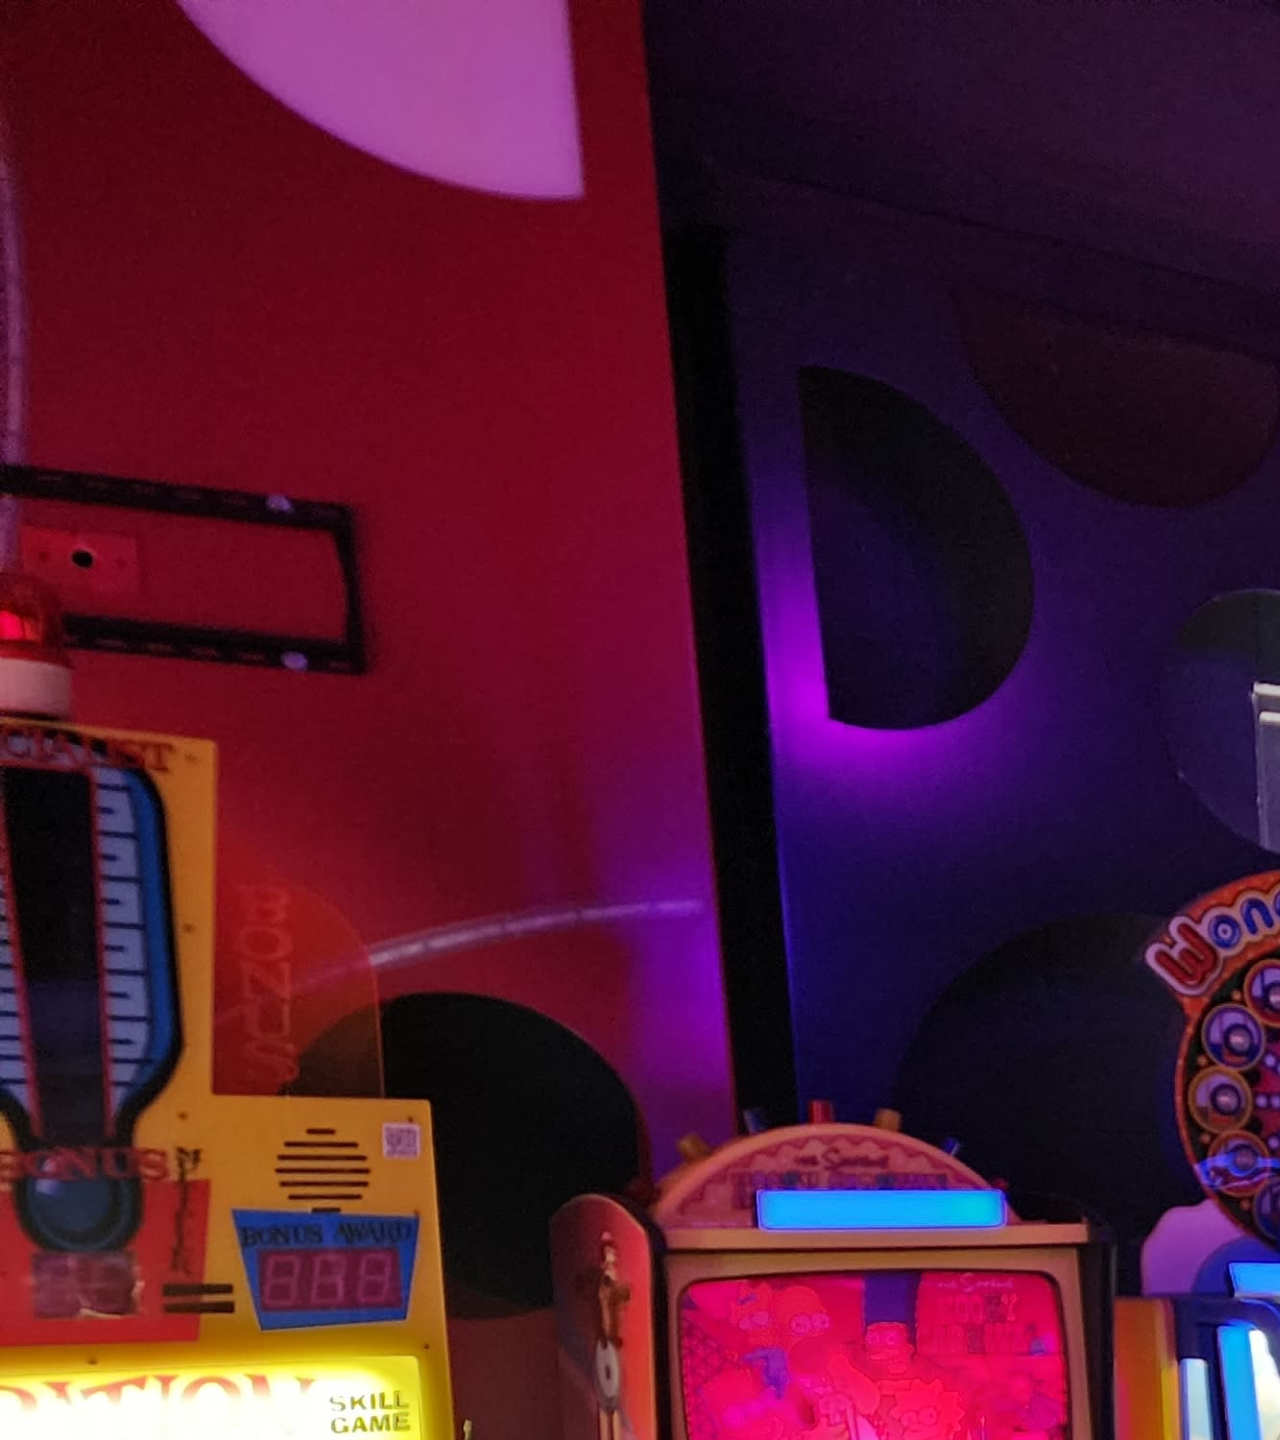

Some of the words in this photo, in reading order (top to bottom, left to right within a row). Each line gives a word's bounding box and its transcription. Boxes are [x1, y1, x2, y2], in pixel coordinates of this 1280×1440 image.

[243, 1224, 323, 1247] BONUS
[337, 1222, 413, 1244] AWARD
[329, 1390, 410, 1412] SKILL
[330, 1411, 411, 1434] GAME
